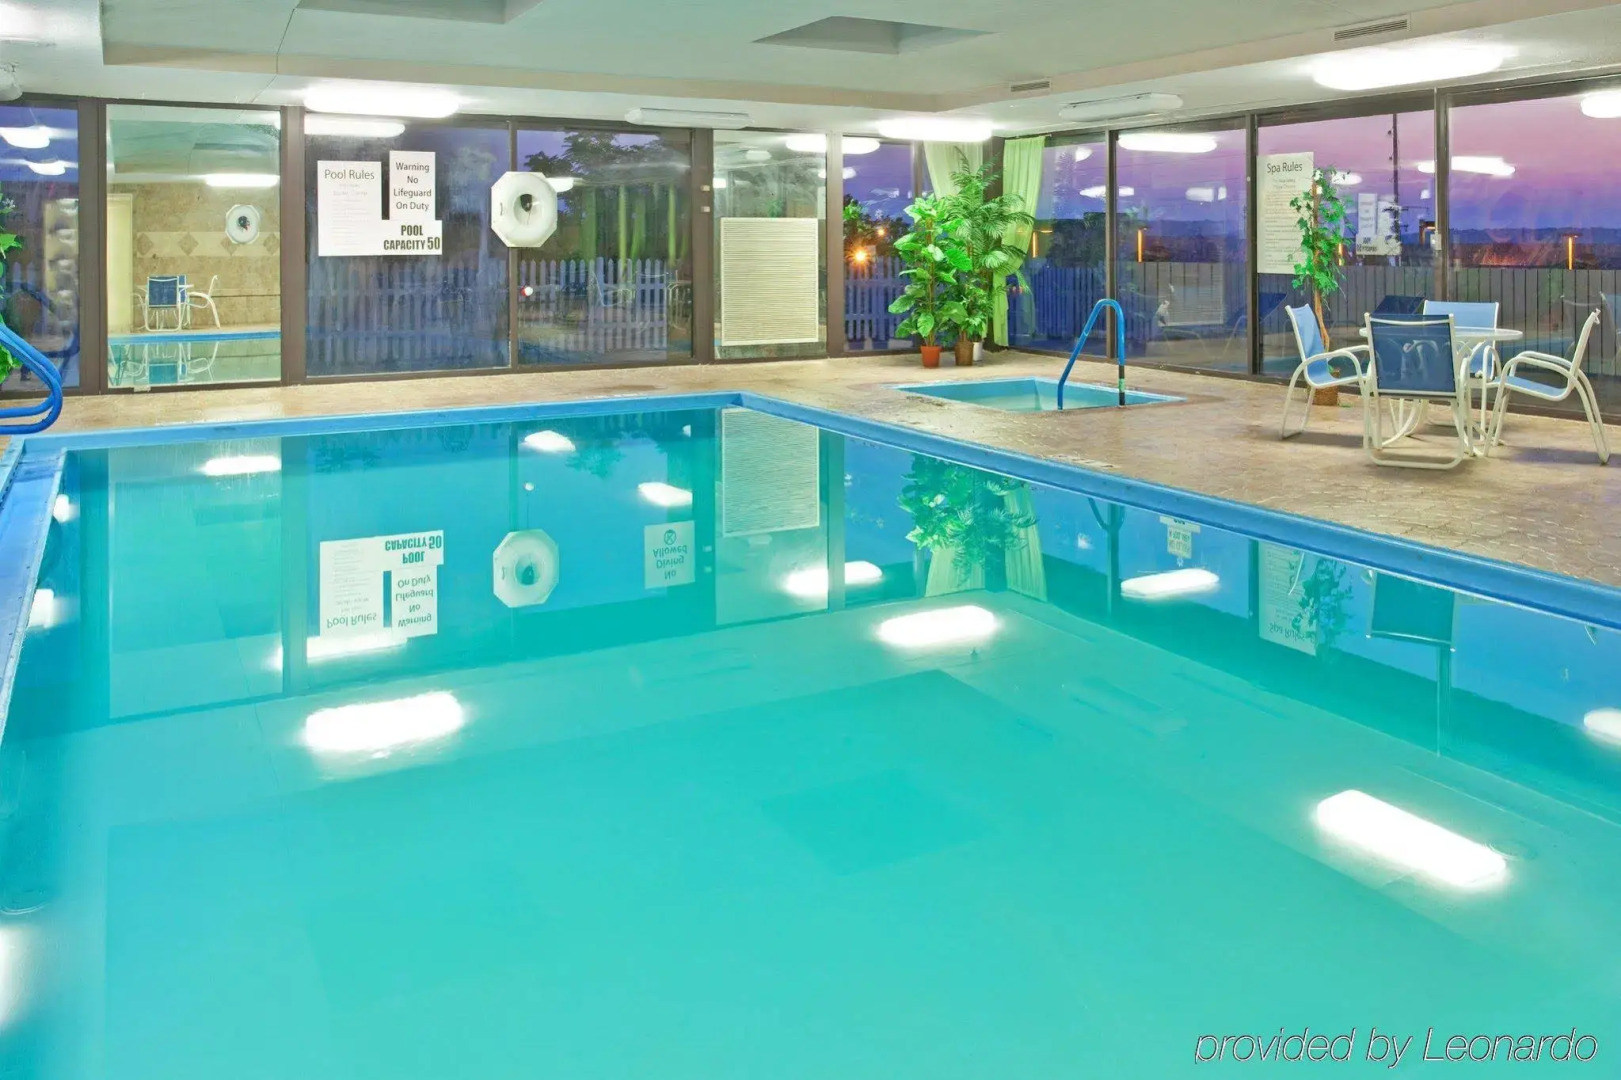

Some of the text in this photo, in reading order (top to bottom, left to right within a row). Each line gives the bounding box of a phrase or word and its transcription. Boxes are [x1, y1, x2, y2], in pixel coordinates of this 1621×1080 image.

[395, 162, 430, 173] Warning
[1266, 161, 1303, 175] Spa Rules
[324, 169, 375, 180] Pool Rules
[406, 175, 419, 184] No
[393, 188, 432, 199] Lifeguard
[395, 201, 430, 212] On Duty
[400, 225, 424, 236] POOL
[383, 236, 441, 251] CAPACITY 50
